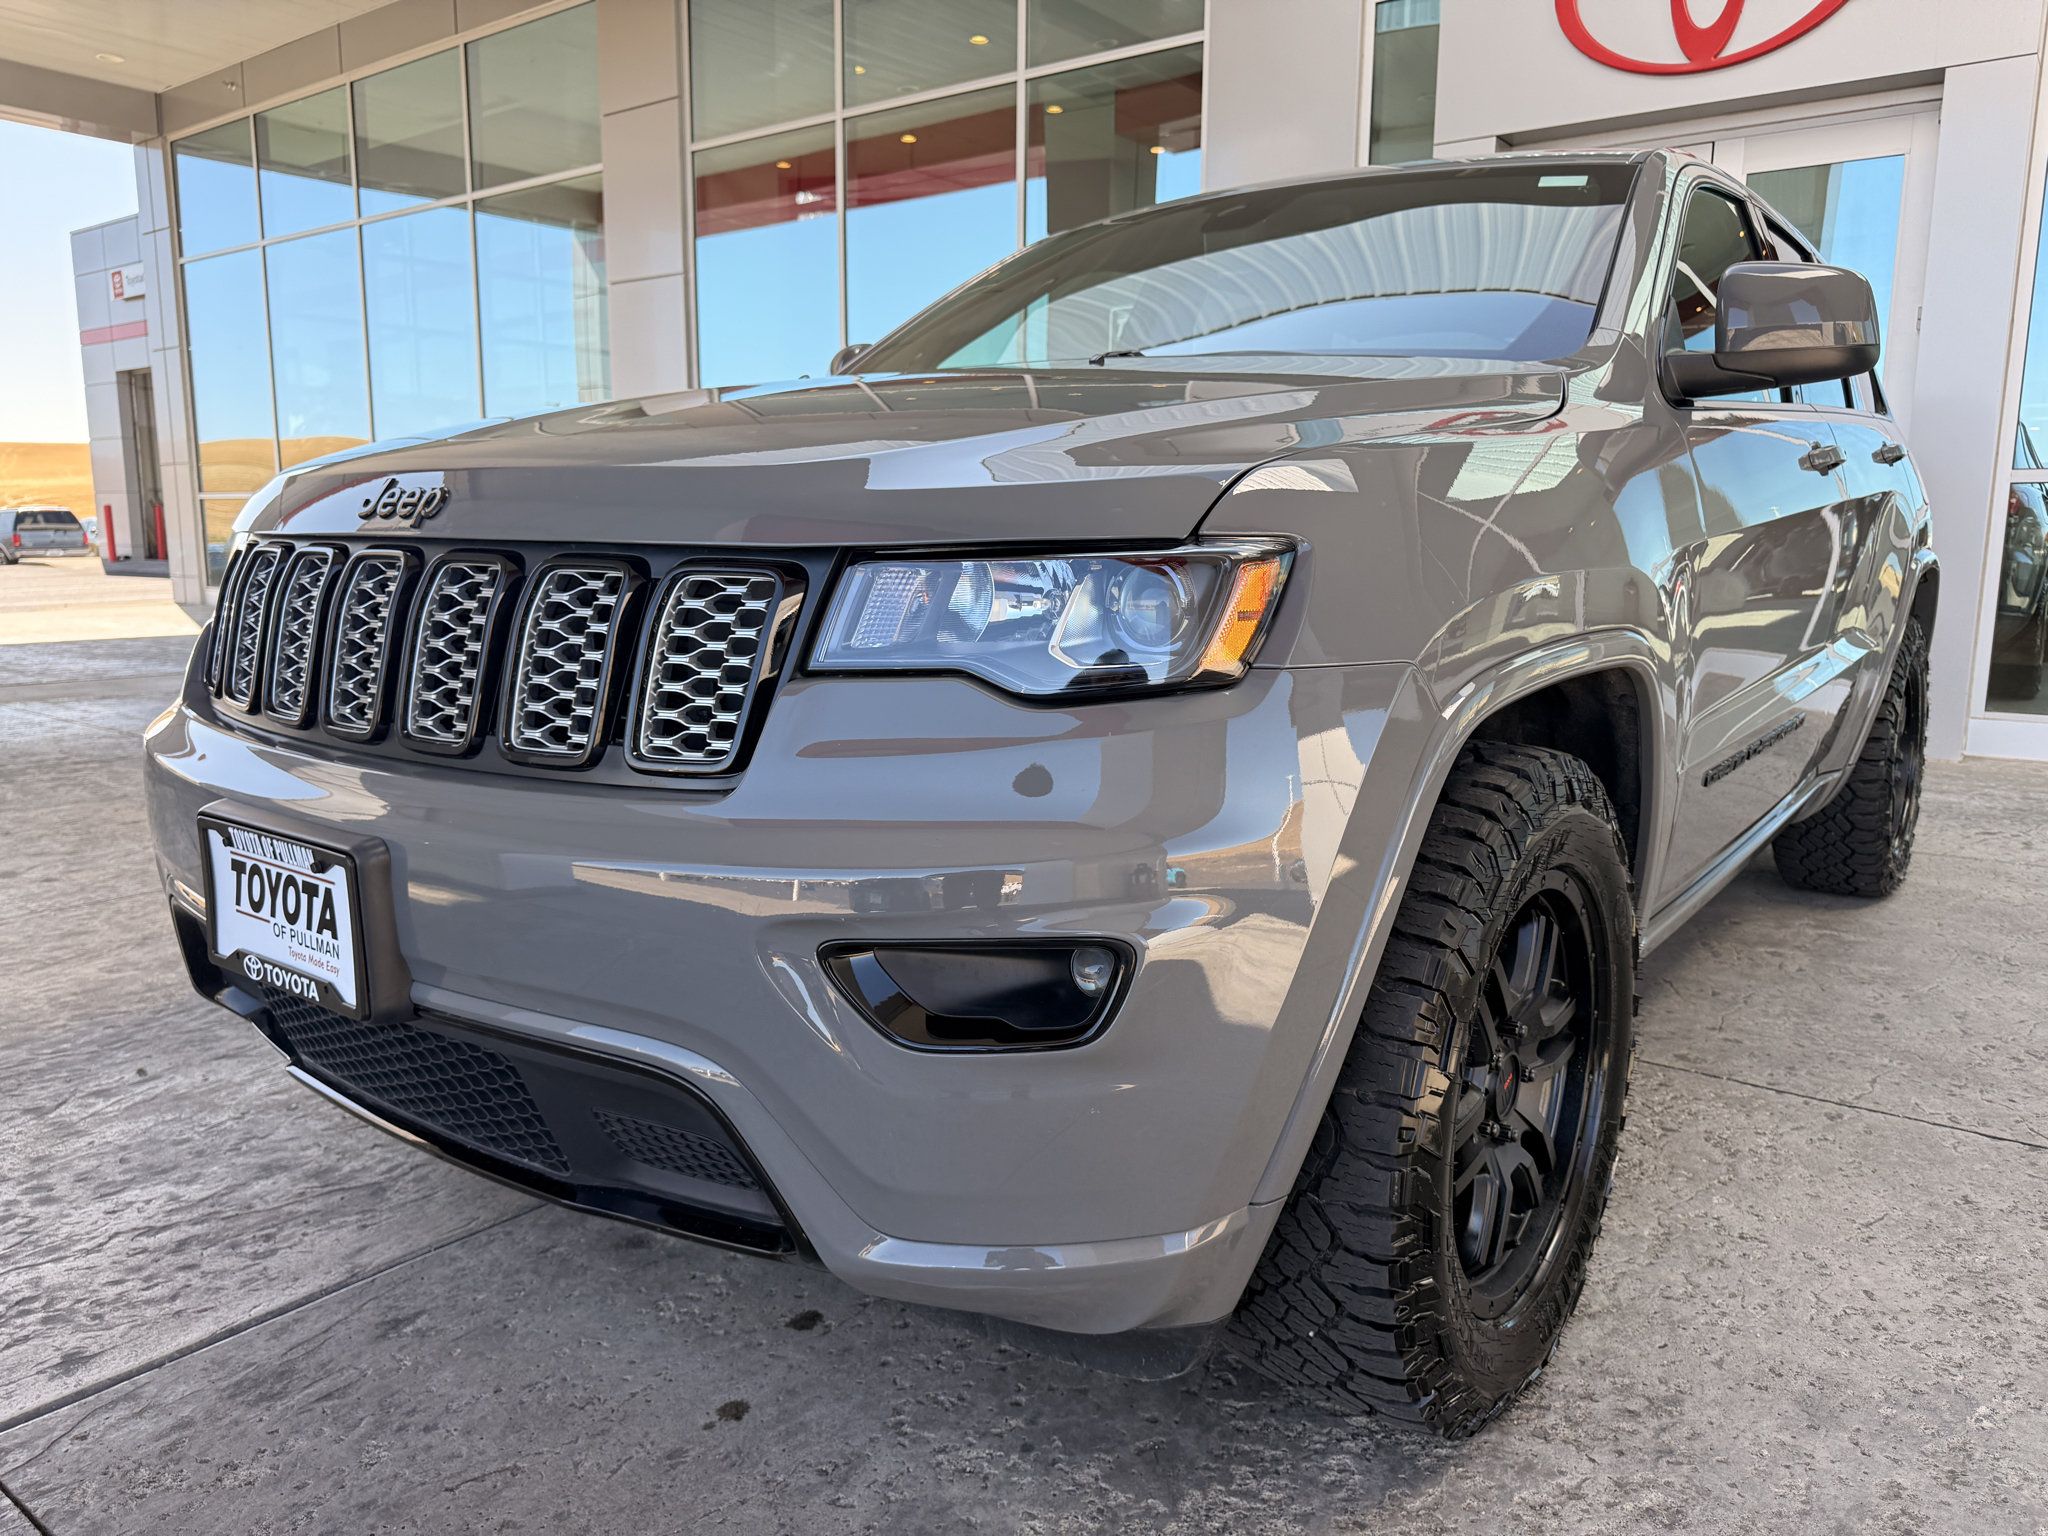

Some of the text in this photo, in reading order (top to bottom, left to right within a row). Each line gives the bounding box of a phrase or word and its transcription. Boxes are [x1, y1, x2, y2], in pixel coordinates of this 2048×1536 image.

[358, 478, 448, 529] Jeep
[228, 827, 315, 871] TOYOTA OF PULLMAN
[231, 858, 339, 941] TOYOTA
[273, 922, 340, 960] OF PULLMAN
[288, 945, 341, 978] Toyota Made Easy
[264, 963, 320, 1002] TOYOTA
